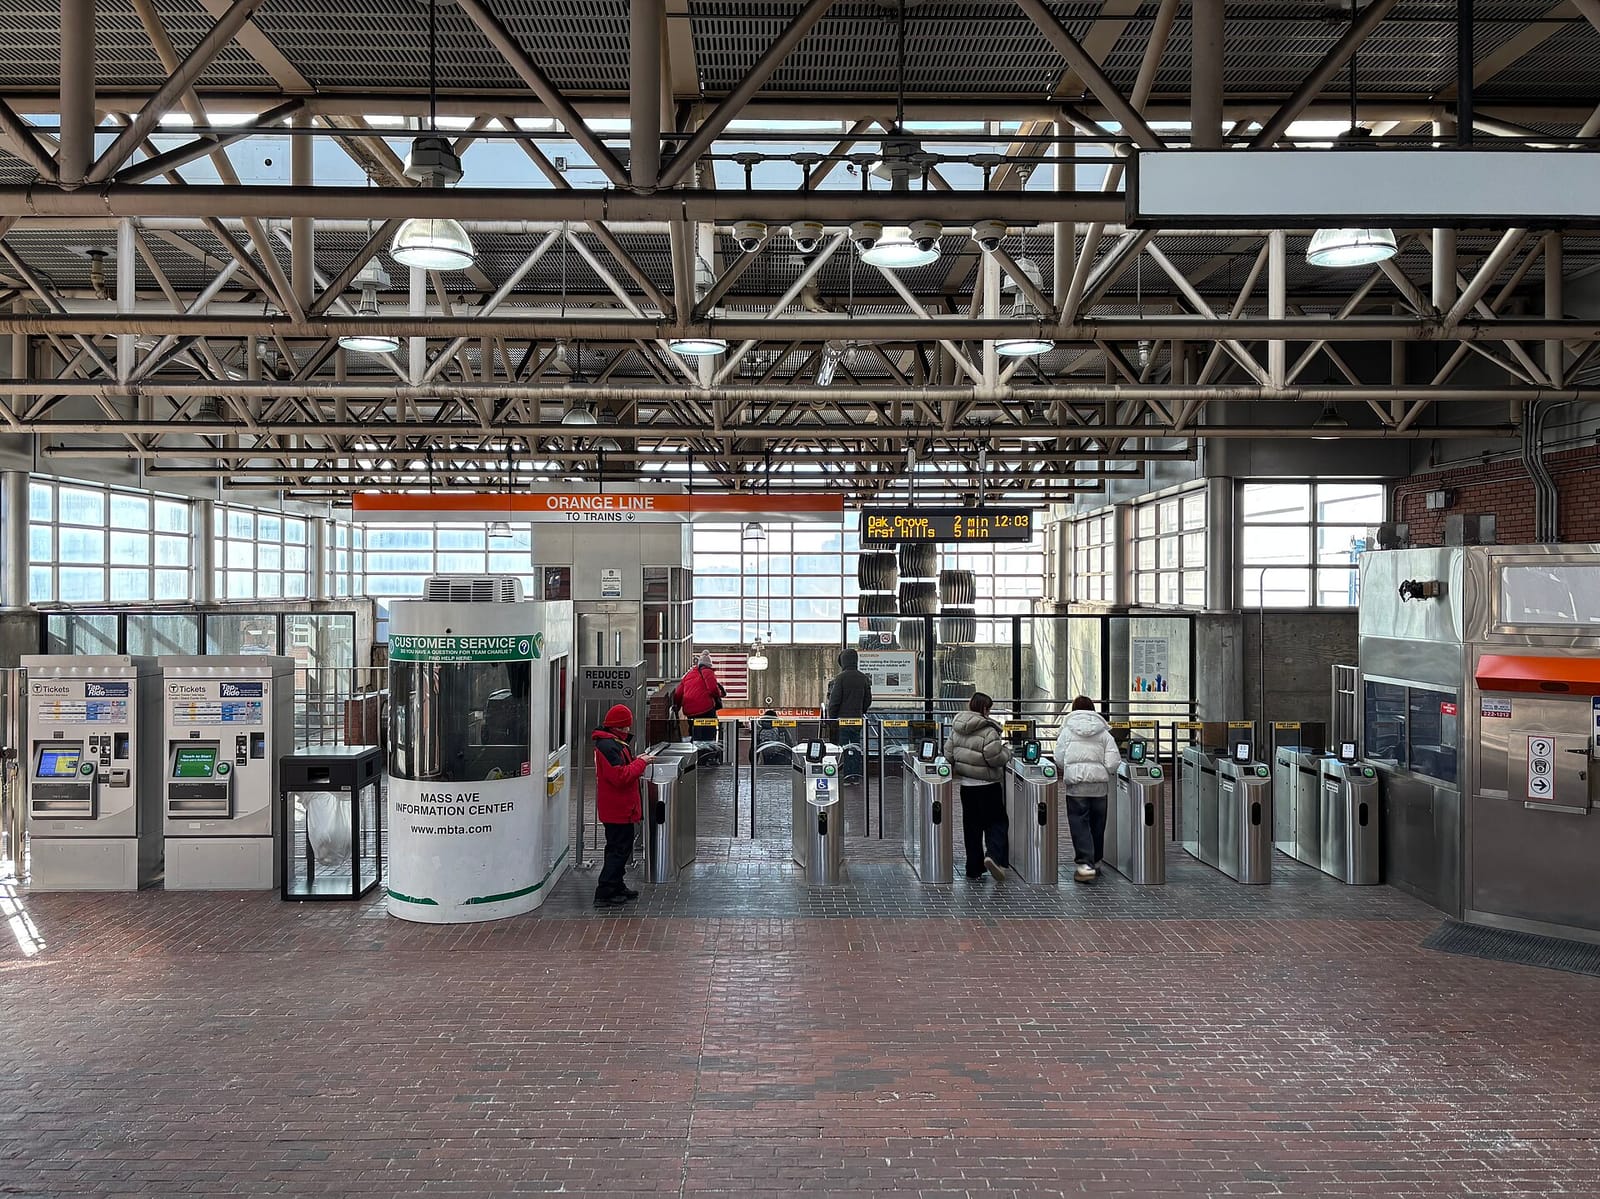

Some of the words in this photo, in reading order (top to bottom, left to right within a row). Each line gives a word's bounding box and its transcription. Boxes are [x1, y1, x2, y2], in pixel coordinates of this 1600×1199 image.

[546, 496, 614, 510] ORANGE
[619, 497, 655, 510] LINE
[566, 512, 581, 521] TO
[584, 512, 622, 521] TRAINS
[868, 515, 889, 527] Oak
[894, 515, 929, 527] Grove
[954, 515, 962, 528] 2
[967, 515, 990, 529] min
[994, 515, 1029, 527] 12:03
[868, 527, 895, 538] Frst
[901, 527, 936, 538] Hills
[954, 528, 962, 538] 5
[967, 528, 990, 538] min
[394, 636, 456, 649] CUSTOMER
[459, 637, 516, 650] SERVICE
[585, 670, 631, 680] REDUCED
[43, 685, 70, 694] Tickets
[87, 684, 101, 692] Tap
[180, 685, 206, 694] Tickets
[222, 684, 236, 692] Tap
[592, 680, 624, 690] FARES
[758, 708, 793, 716] ONGE
[795, 708, 815, 716] LINE
[420, 792, 453, 803] MASS
[456, 792, 480, 803] AVE
[395, 802, 465, 816] INFORMATION
[468, 801, 514, 816] CENTER
[410, 824, 492, 835] www.mbta.com
